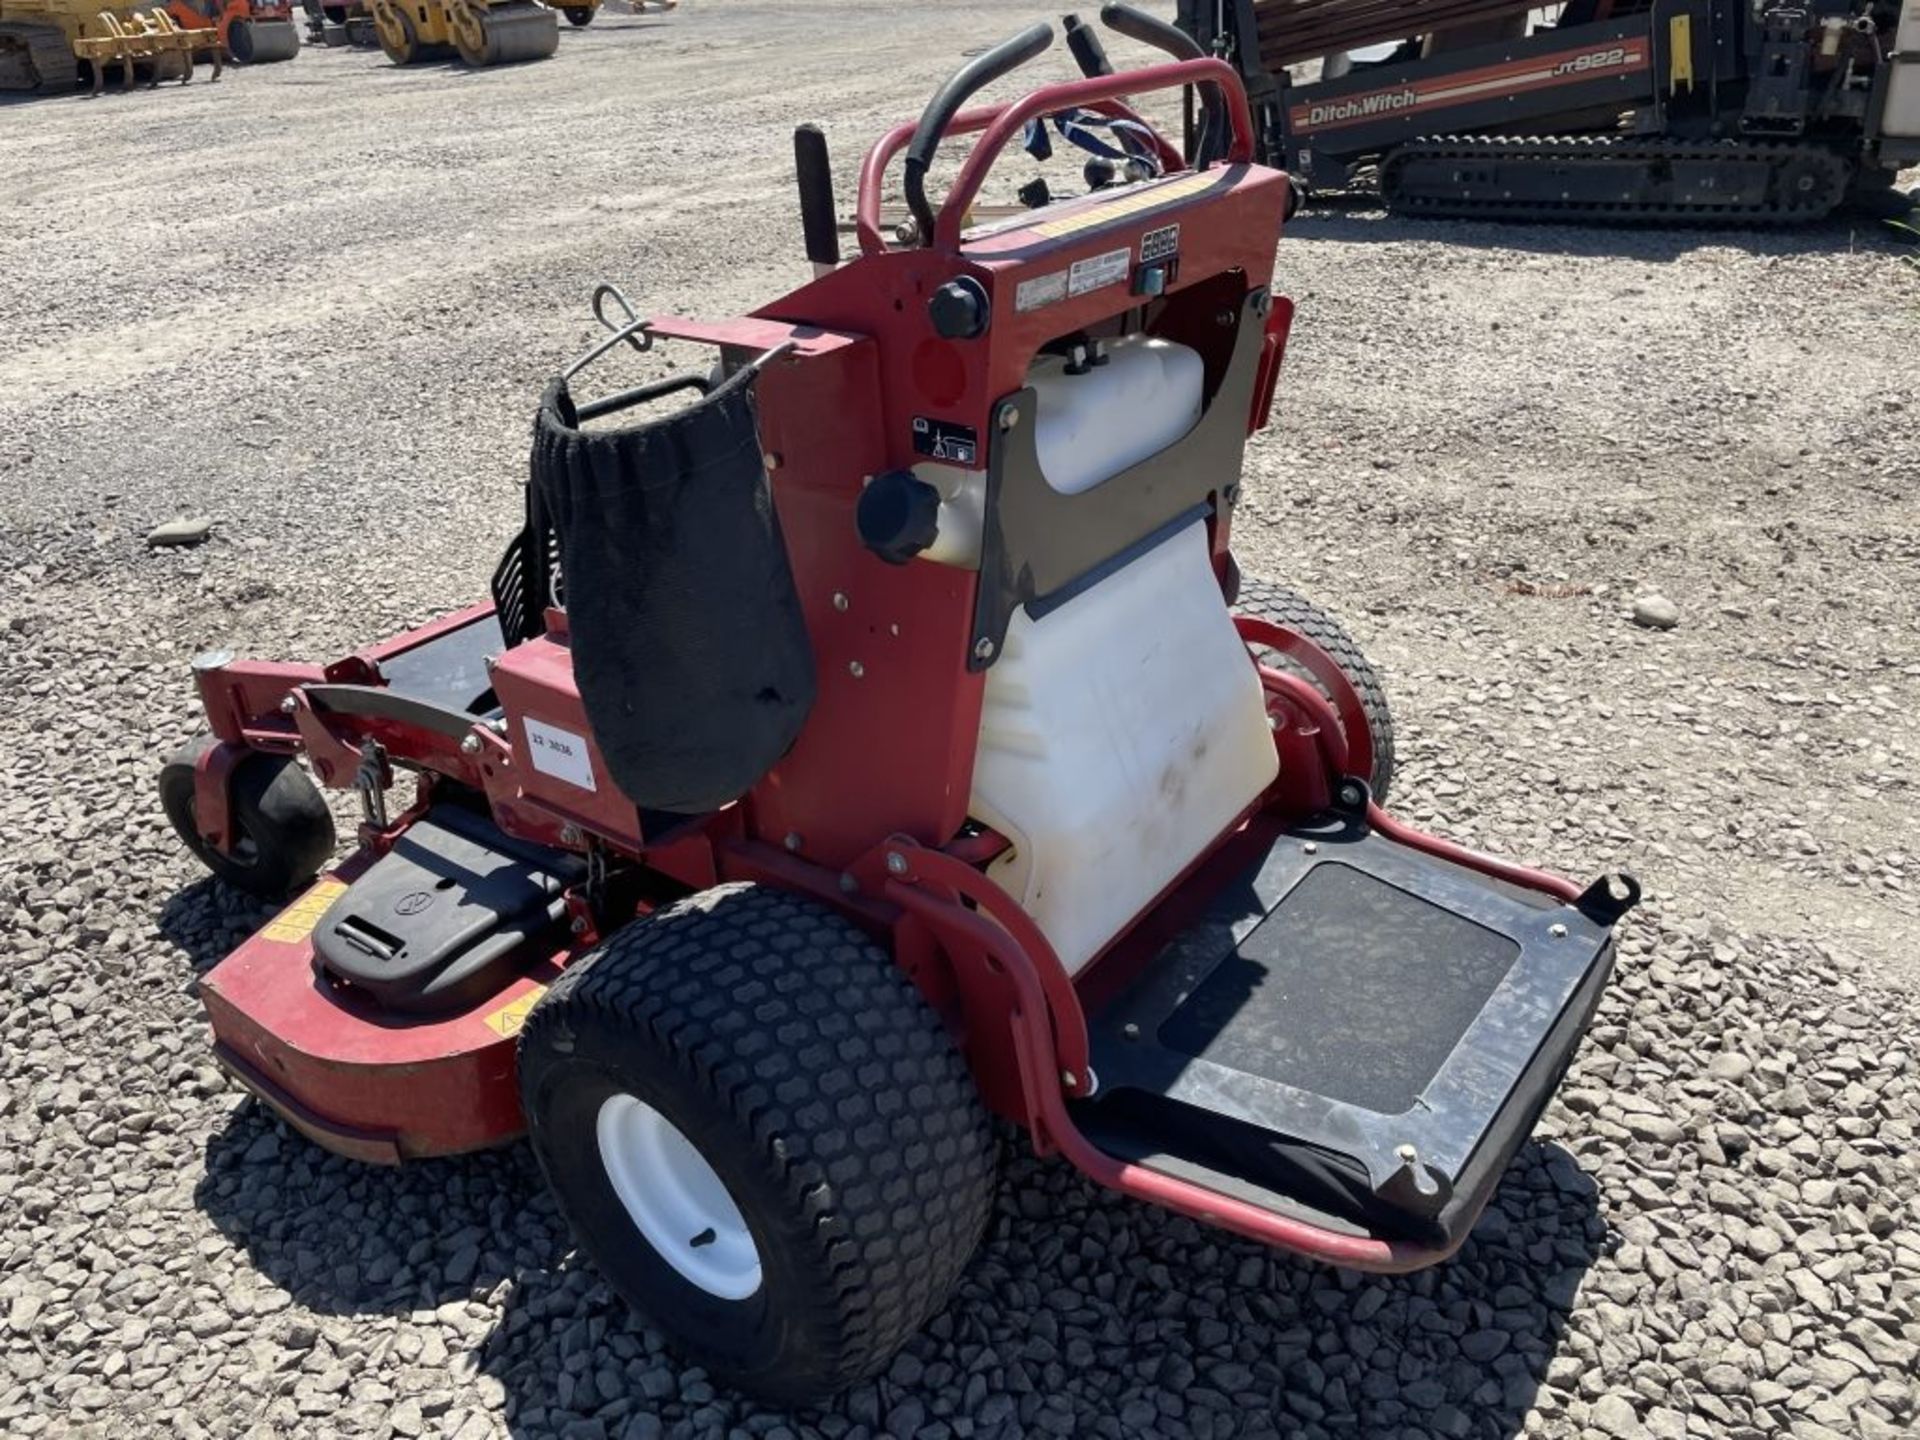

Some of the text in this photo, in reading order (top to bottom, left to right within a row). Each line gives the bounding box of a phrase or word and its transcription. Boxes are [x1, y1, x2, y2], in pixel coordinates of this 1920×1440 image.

[1554, 48, 1624, 75] JT922
[1310, 90, 1415, 124] Ditch Witch
